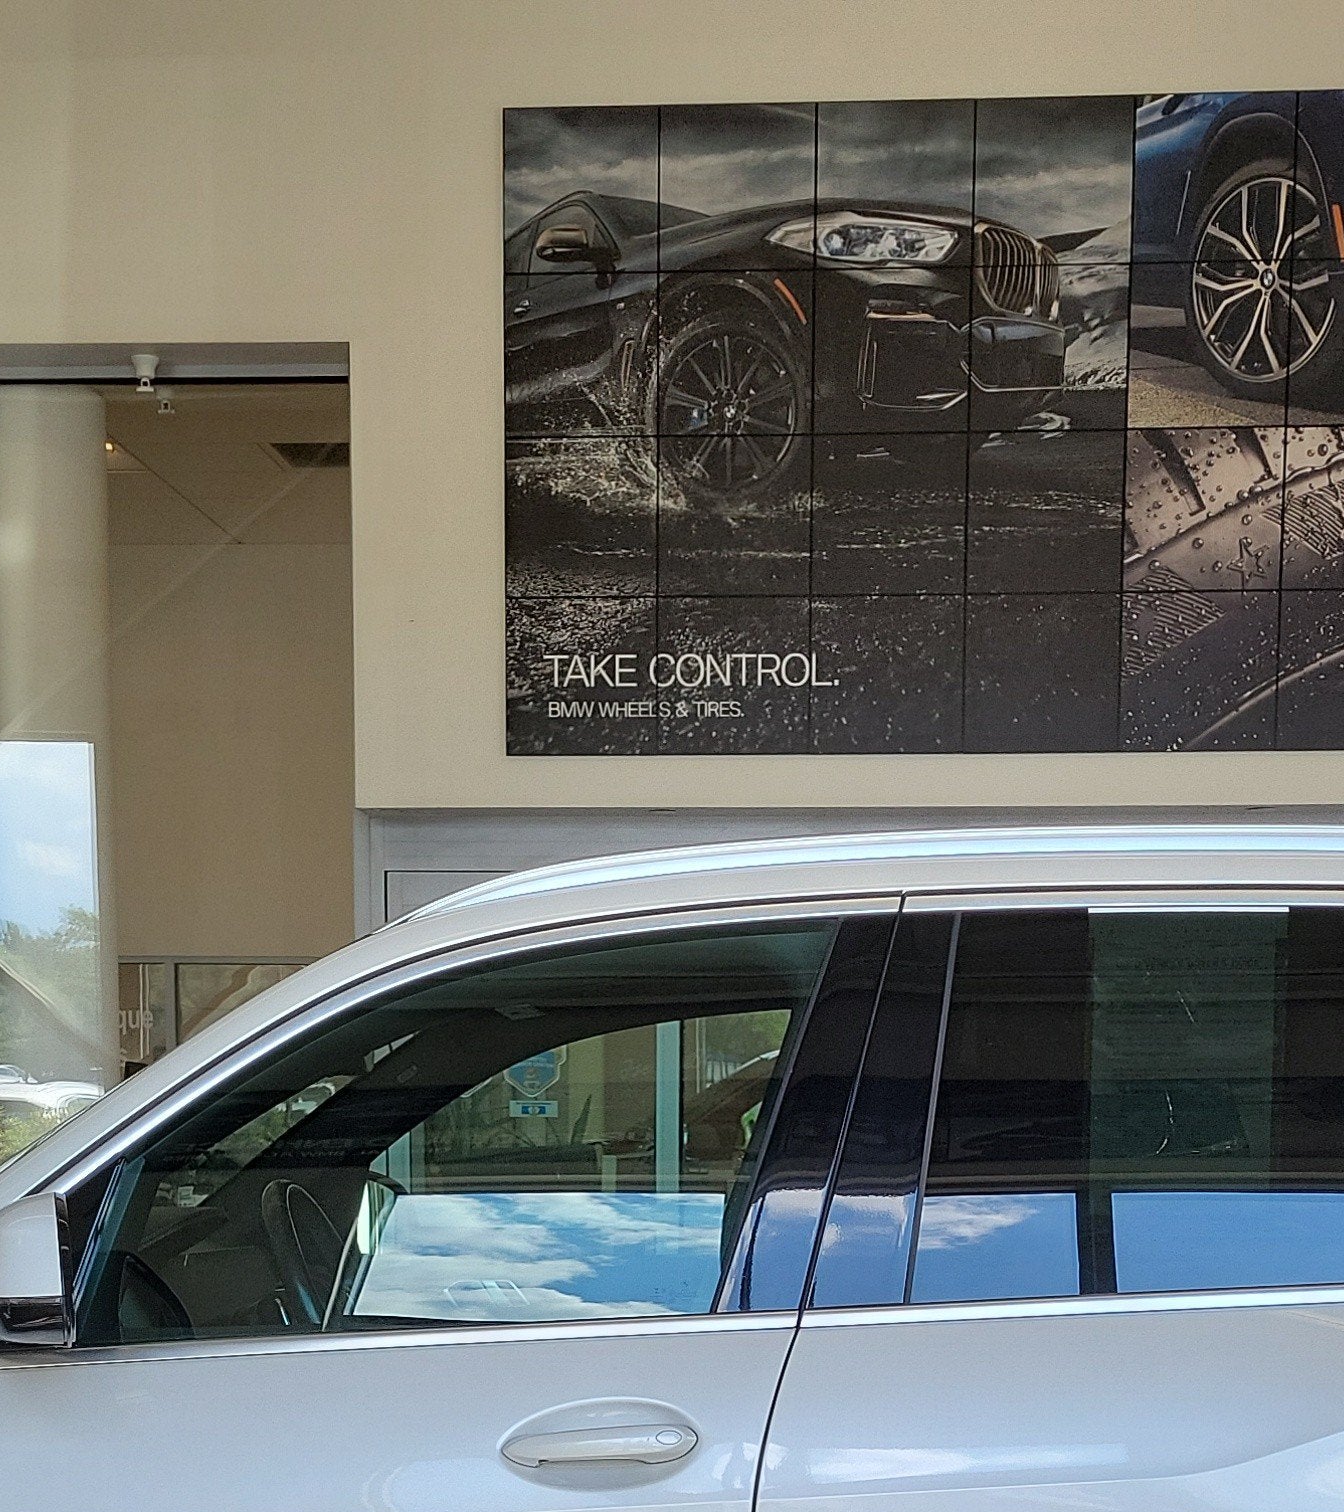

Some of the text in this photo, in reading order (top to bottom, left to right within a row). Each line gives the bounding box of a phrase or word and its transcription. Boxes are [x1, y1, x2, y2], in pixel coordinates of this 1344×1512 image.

[543, 652, 840, 688] TAKE CONTROL.
[548, 700, 745, 718] BMW WHEELS & TIRES.
